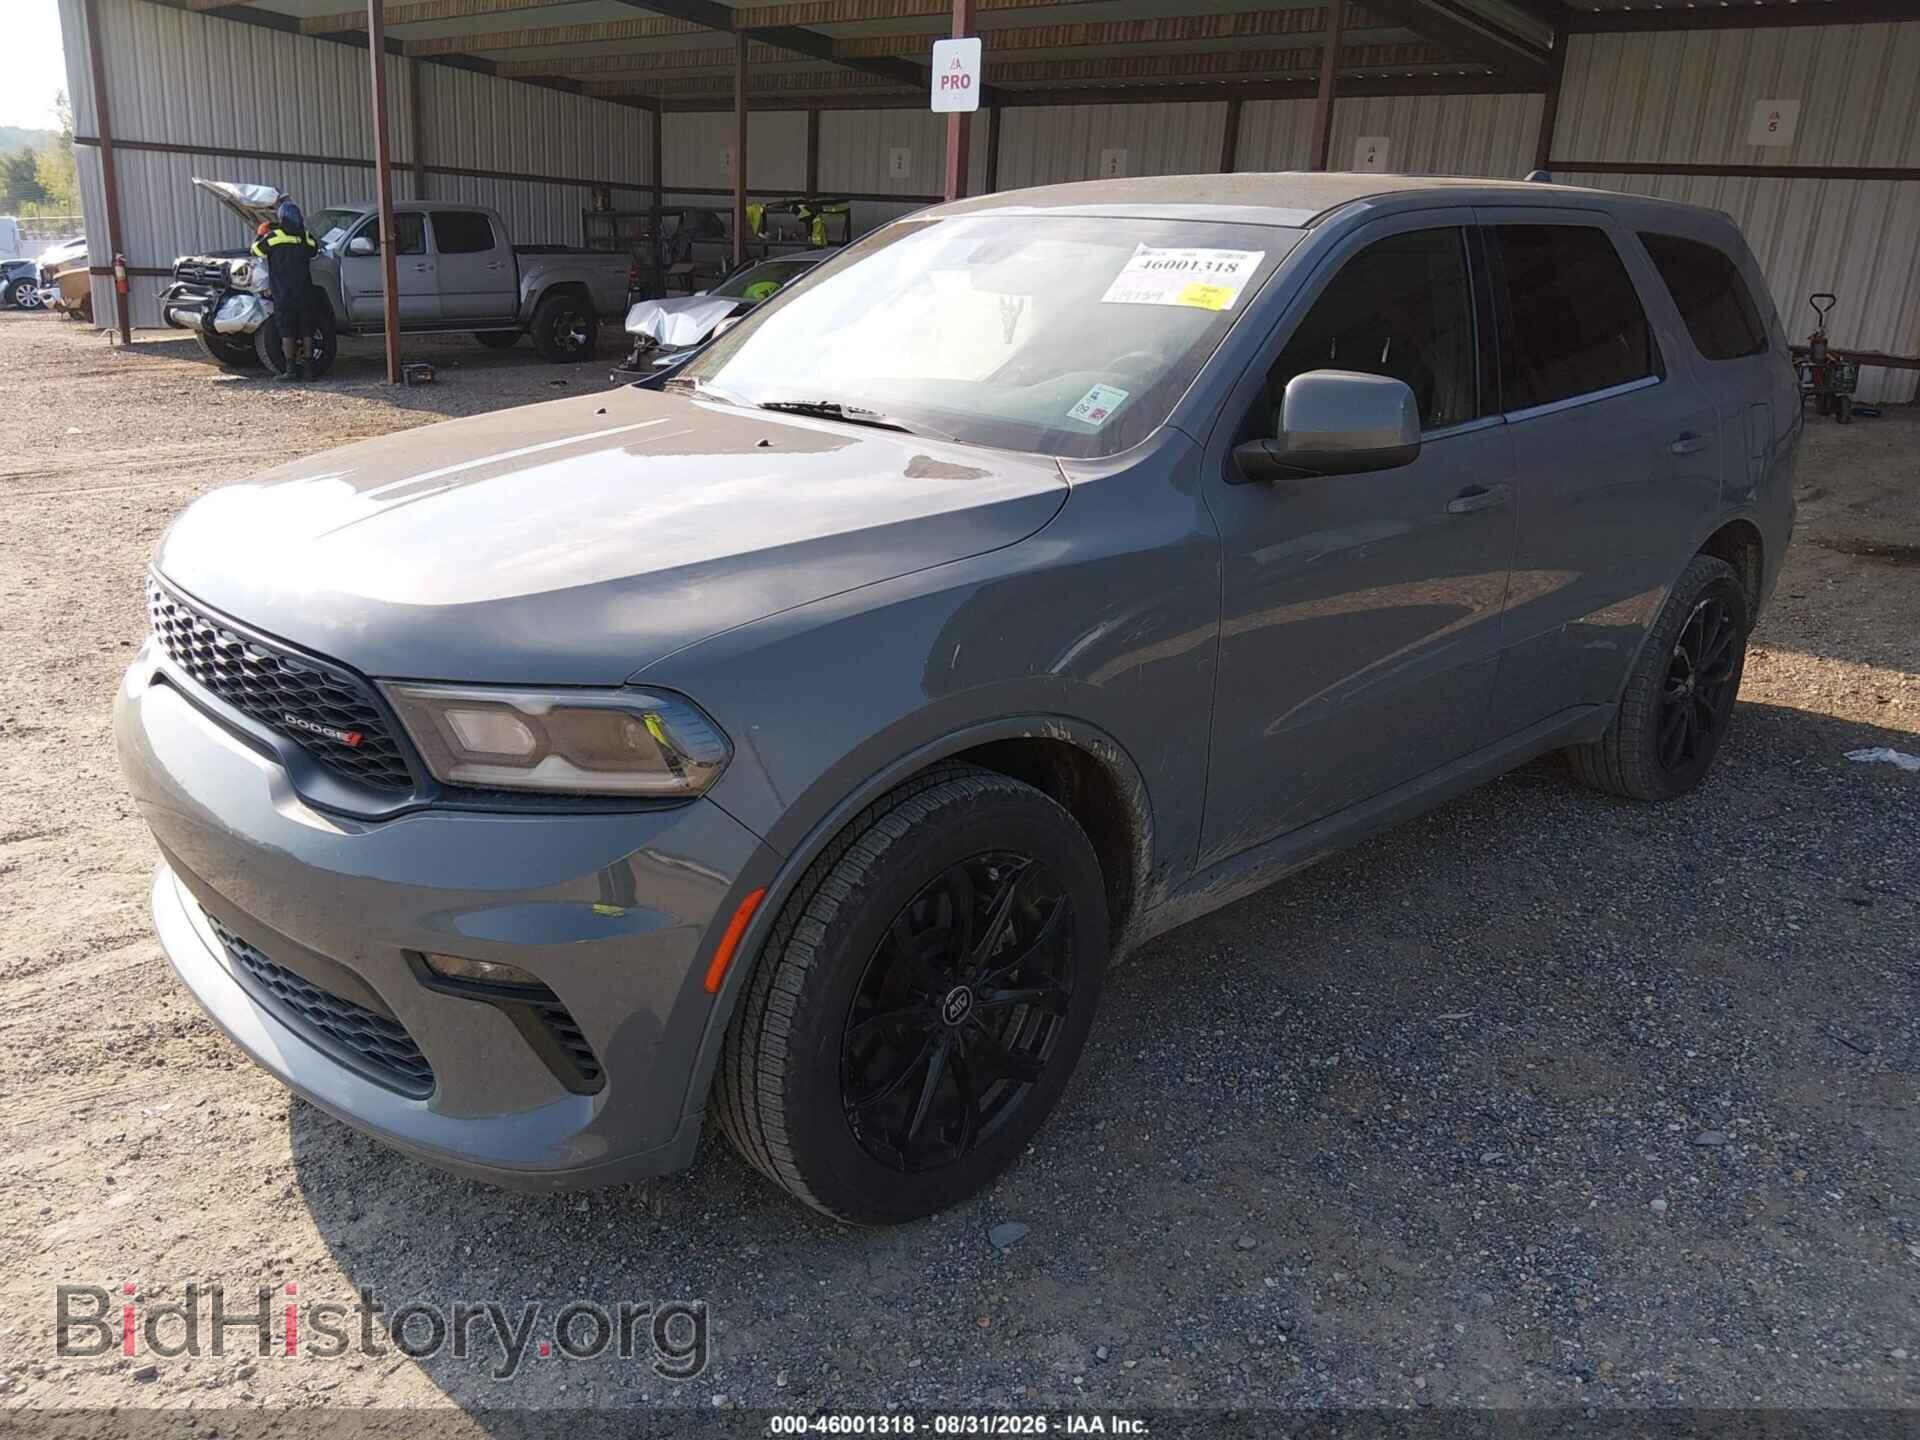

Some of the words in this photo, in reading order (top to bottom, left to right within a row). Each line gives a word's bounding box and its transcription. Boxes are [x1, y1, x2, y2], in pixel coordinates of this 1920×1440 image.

[941, 74, 971, 90] PRO
[1768, 121, 1777, 133] 5
[285, 714, 352, 743] DODGE
